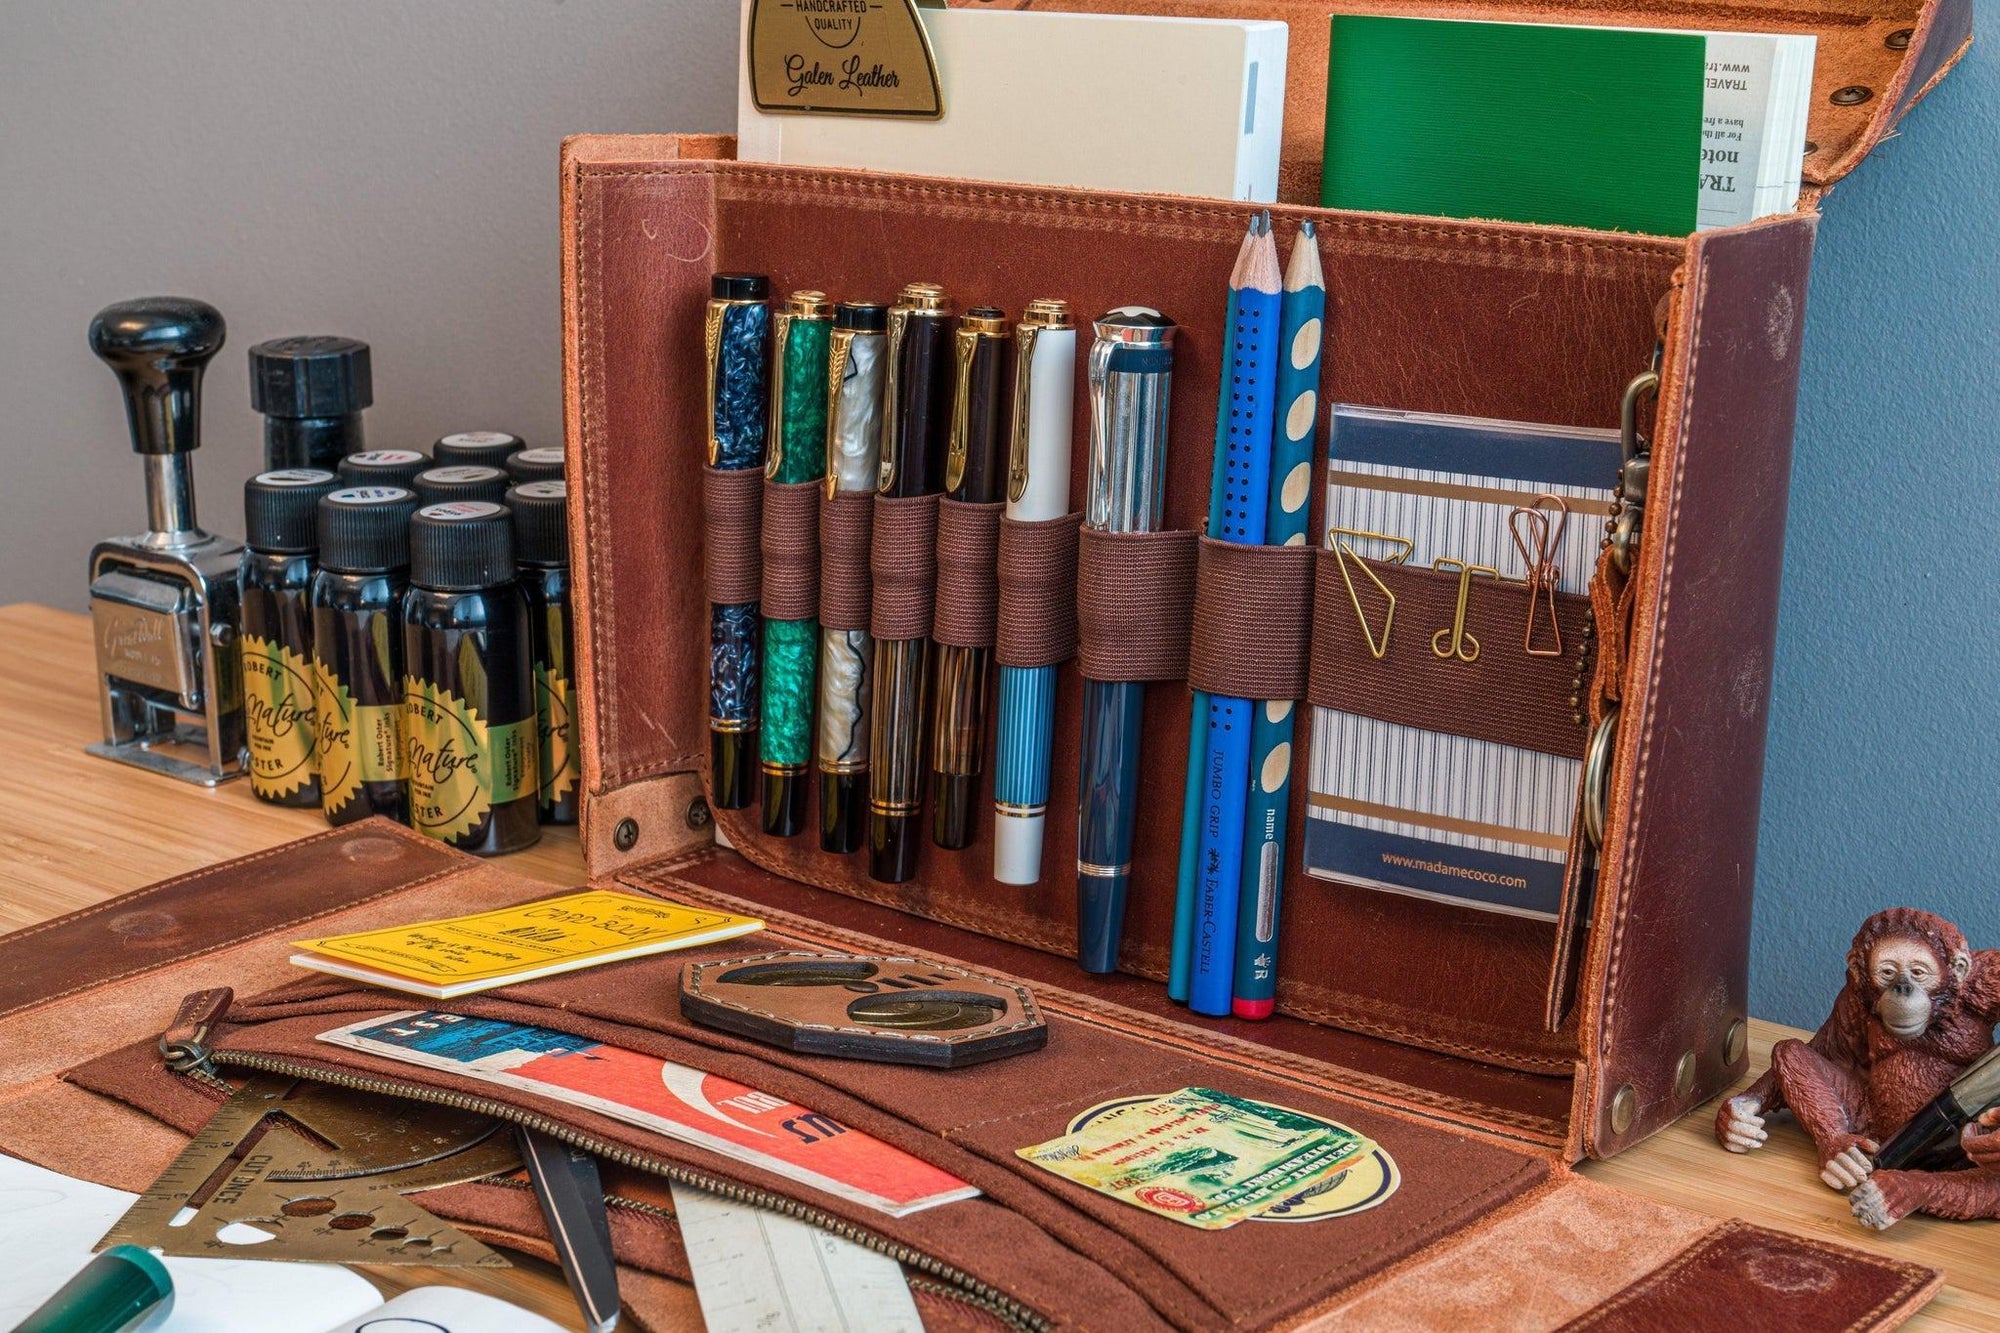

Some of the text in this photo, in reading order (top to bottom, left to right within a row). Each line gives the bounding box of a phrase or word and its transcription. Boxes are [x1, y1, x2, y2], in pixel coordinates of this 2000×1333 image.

[796, 0, 867, 12] HANDCRAFTED
[814, 18, 853, 30] QUALITY
[784, 54, 900, 97] Galen Leather
[1714, 131, 1726, 139] all
[1724, 120, 1744, 128] have
[1727, 132, 1742, 141] For
[1265, 808, 1276, 840] name
[1200, 750, 1225, 974] JUMBO GRIP FABER-CASTELL
[1382, 853, 1527, 889] www.madamecoco.com
[524, 908, 597, 924] CARD
[593, 920, 668, 940] BOOK
[1254, 969, 1269, 980] R
[240, 1155, 273, 1174] CUT
[1241, 1144, 1332, 1189] STEAMBOAT
[1291, 1143, 1359, 1179] DETROIT
[1194, 1188, 1271, 1221] BUFFALO
